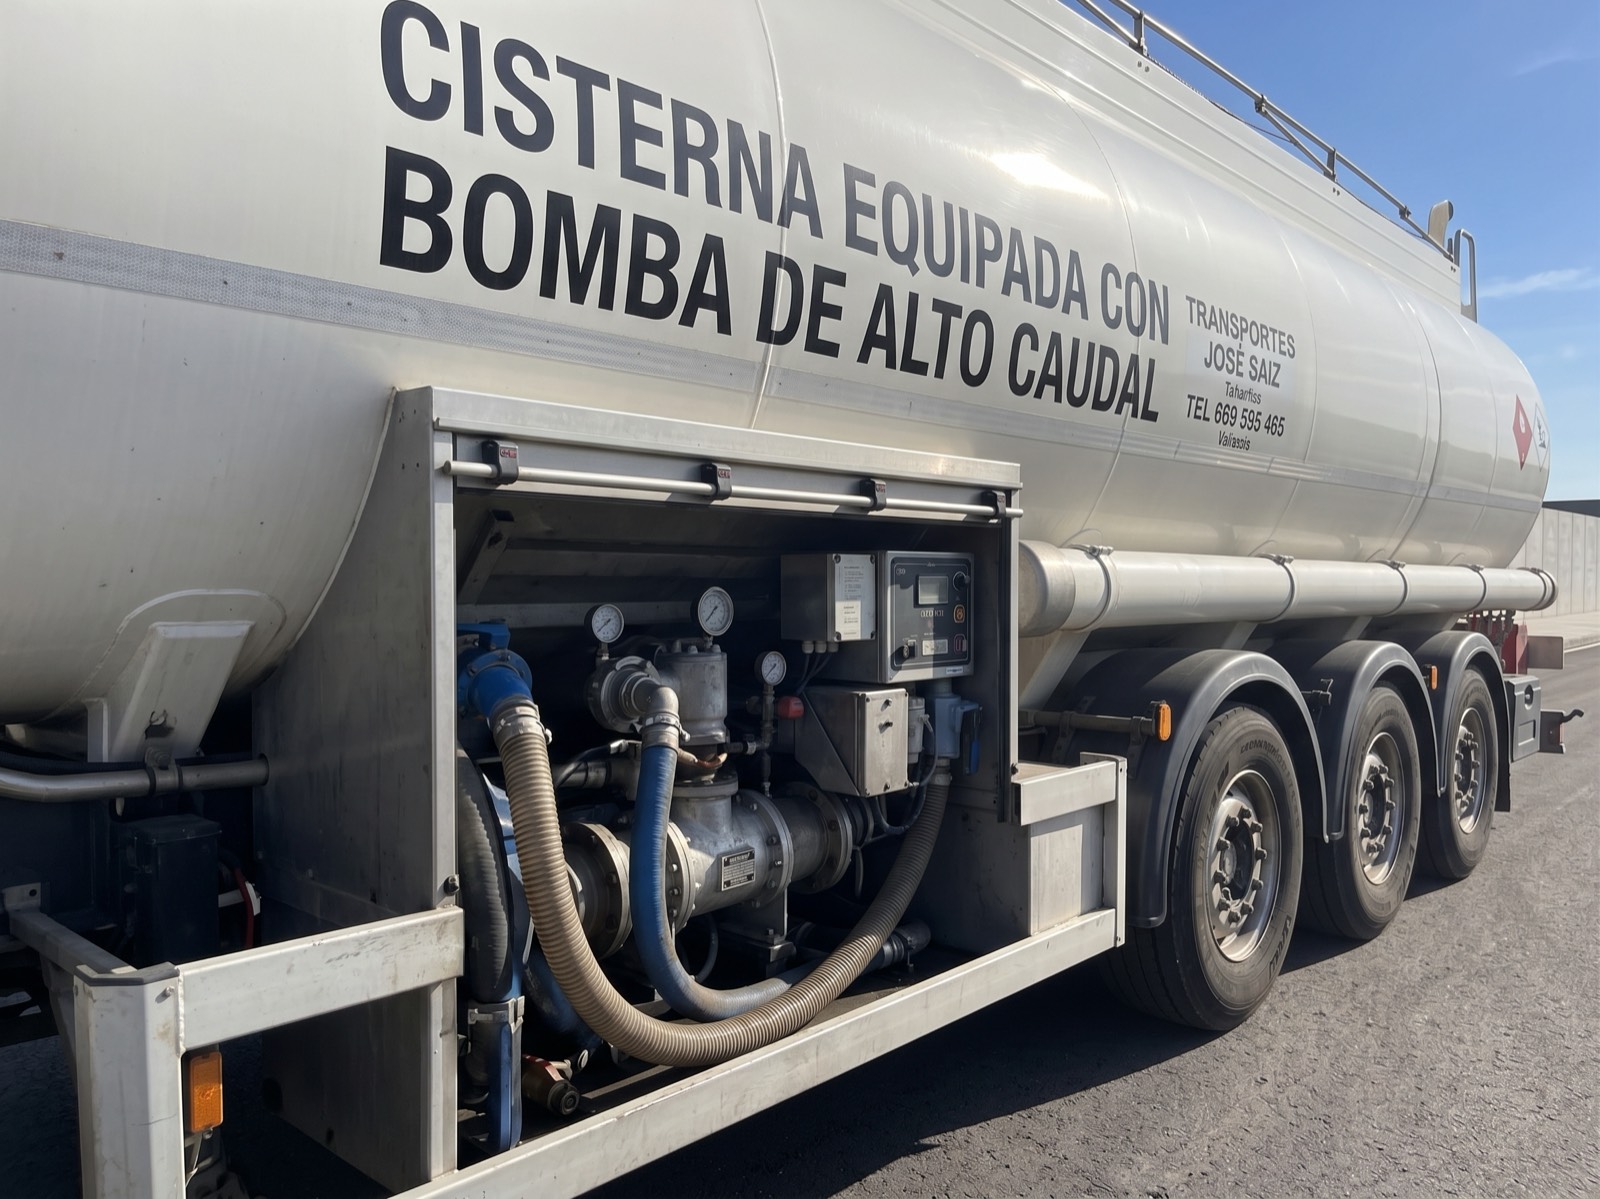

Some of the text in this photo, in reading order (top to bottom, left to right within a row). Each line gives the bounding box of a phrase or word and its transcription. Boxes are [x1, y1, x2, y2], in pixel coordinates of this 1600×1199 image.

[380, 0, 1169, 345] CISTERNA EQUIPADA CON
[380, 146, 1159, 422] BOMBA DE ALTO CAUDAL
[1185, 295, 1296, 359] TRANSPORTES
[1204, 341, 1281, 388] JOSÉ SAIZ
[1187, 394, 1285, 437] TEL 669 595 465
